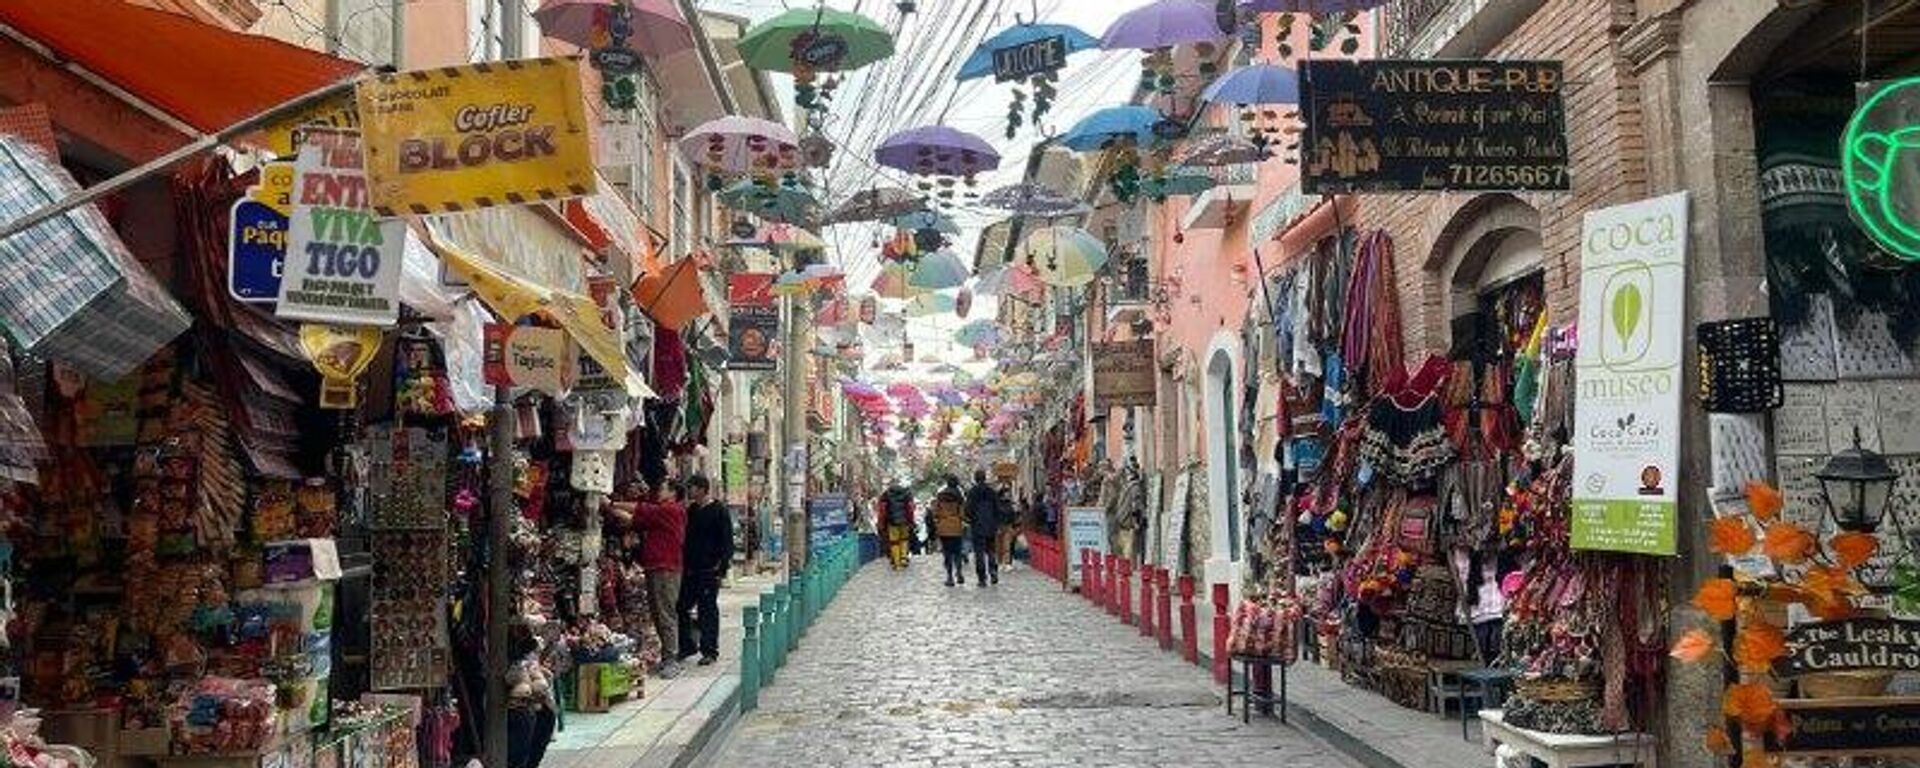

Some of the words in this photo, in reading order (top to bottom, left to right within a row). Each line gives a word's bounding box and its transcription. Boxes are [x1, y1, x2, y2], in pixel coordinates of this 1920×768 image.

[995, 39, 1059, 77] WELCOME
[456, 104, 534, 133] Cofler
[399, 126, 555, 173] BLOCK
[1449, 165, 1563, 186] 71265667
[310, 207, 384, 246] VIVA
[1588, 213, 1675, 255] coca
[305, 241, 381, 279] TIGO
[1583, 373, 1672, 400] museo
[1806, 628, 1839, 641] The
[1845, 622, 1920, 651] Leaky
